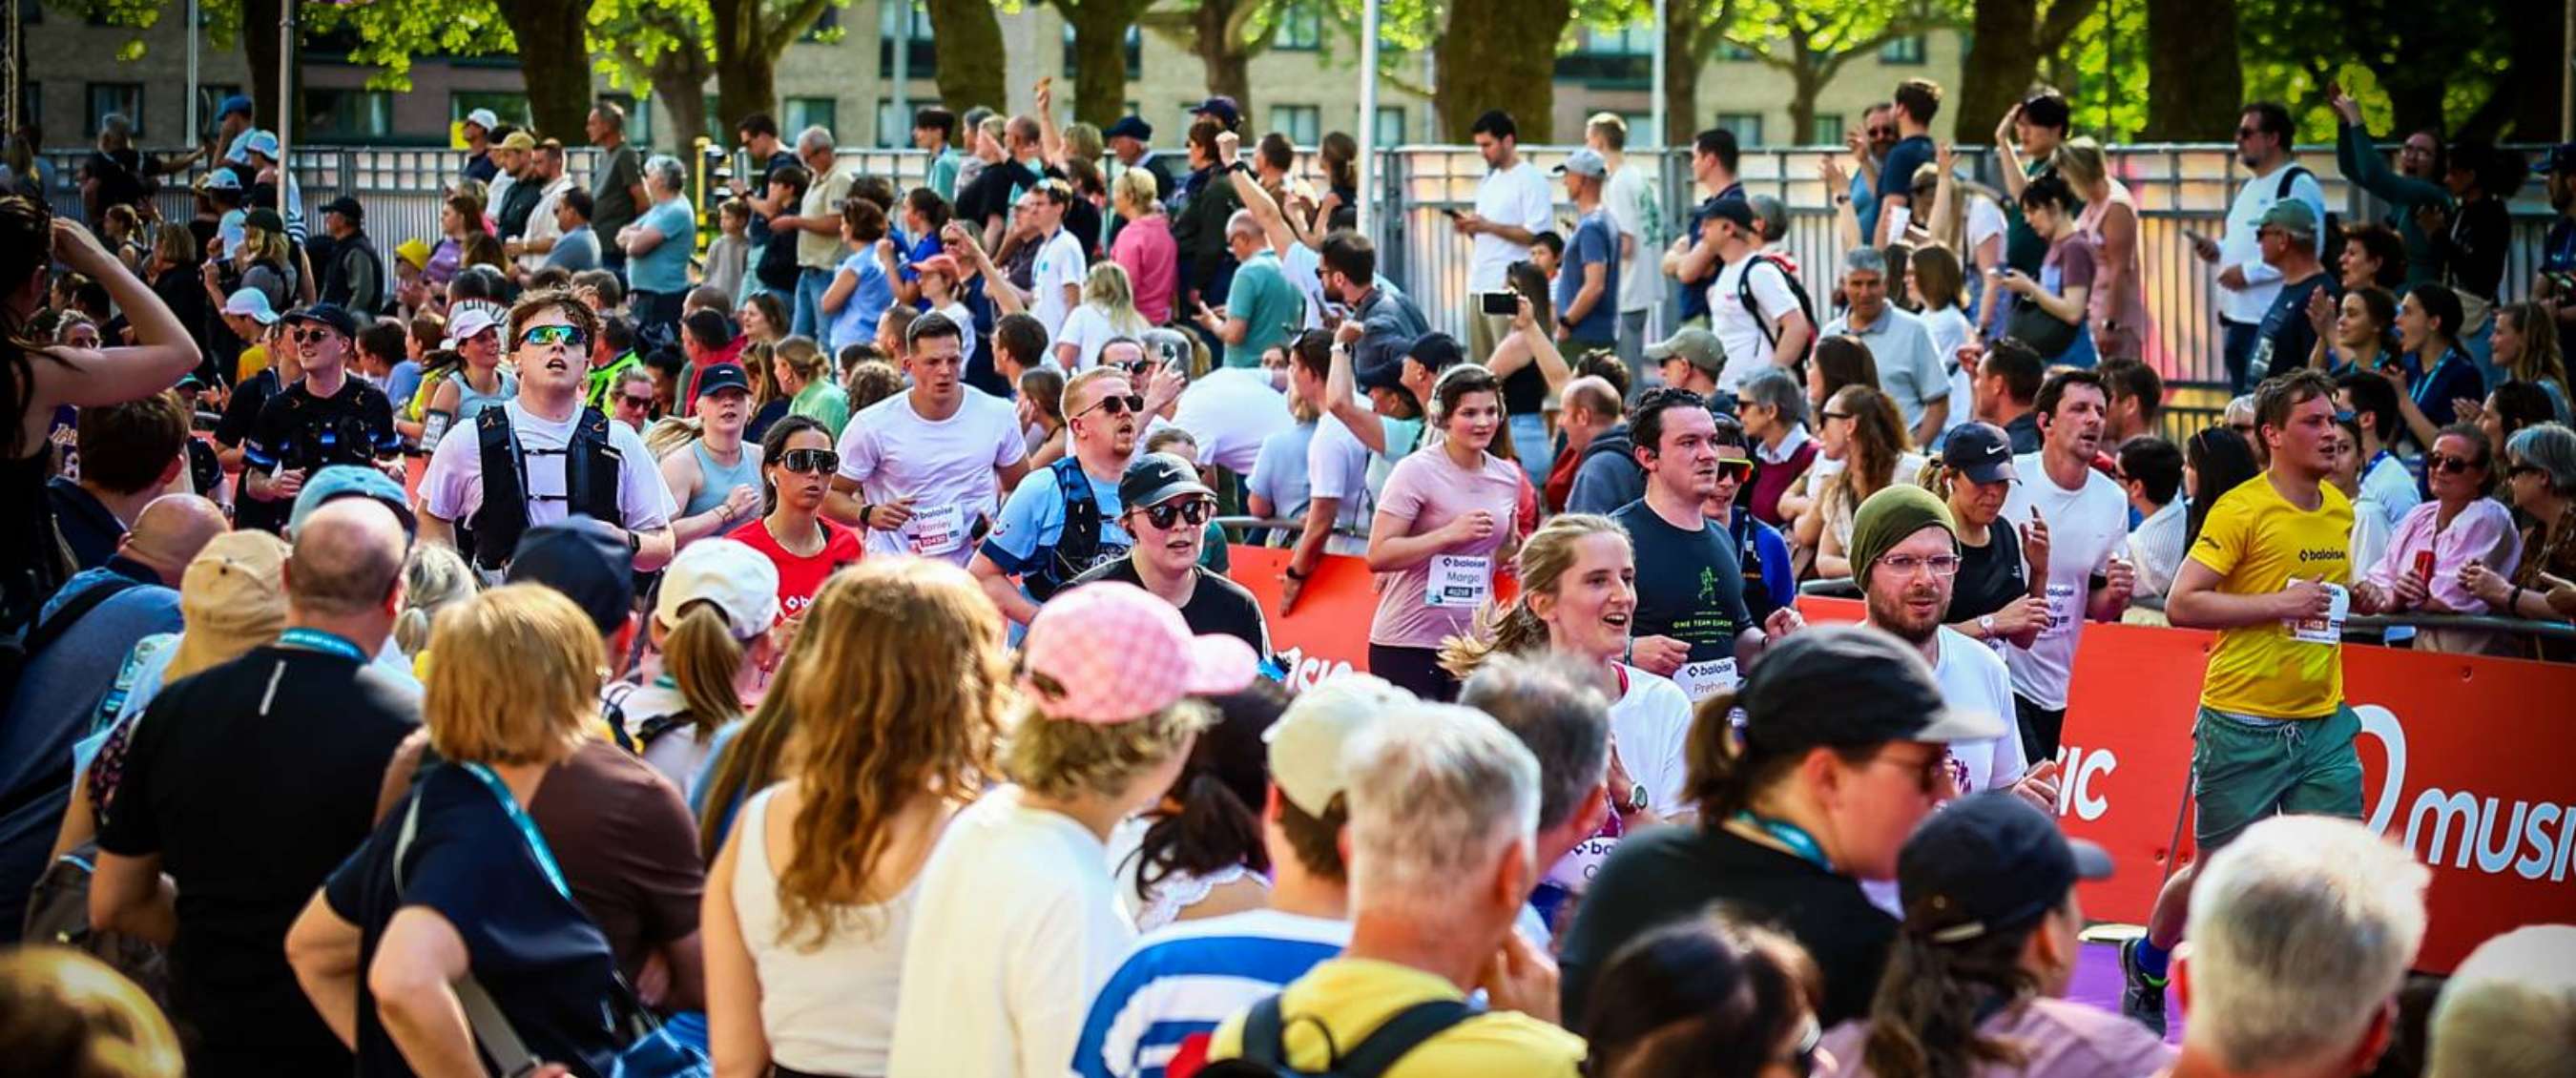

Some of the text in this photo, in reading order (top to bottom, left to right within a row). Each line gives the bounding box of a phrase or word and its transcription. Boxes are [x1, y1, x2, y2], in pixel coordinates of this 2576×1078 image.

[917, 520, 952, 533] Stanley
[2309, 548, 2346, 561] baloise
[1454, 559, 1485, 568] baloise
[1447, 572, 1480, 585] Margo
[1699, 663, 1732, 676] baloise
